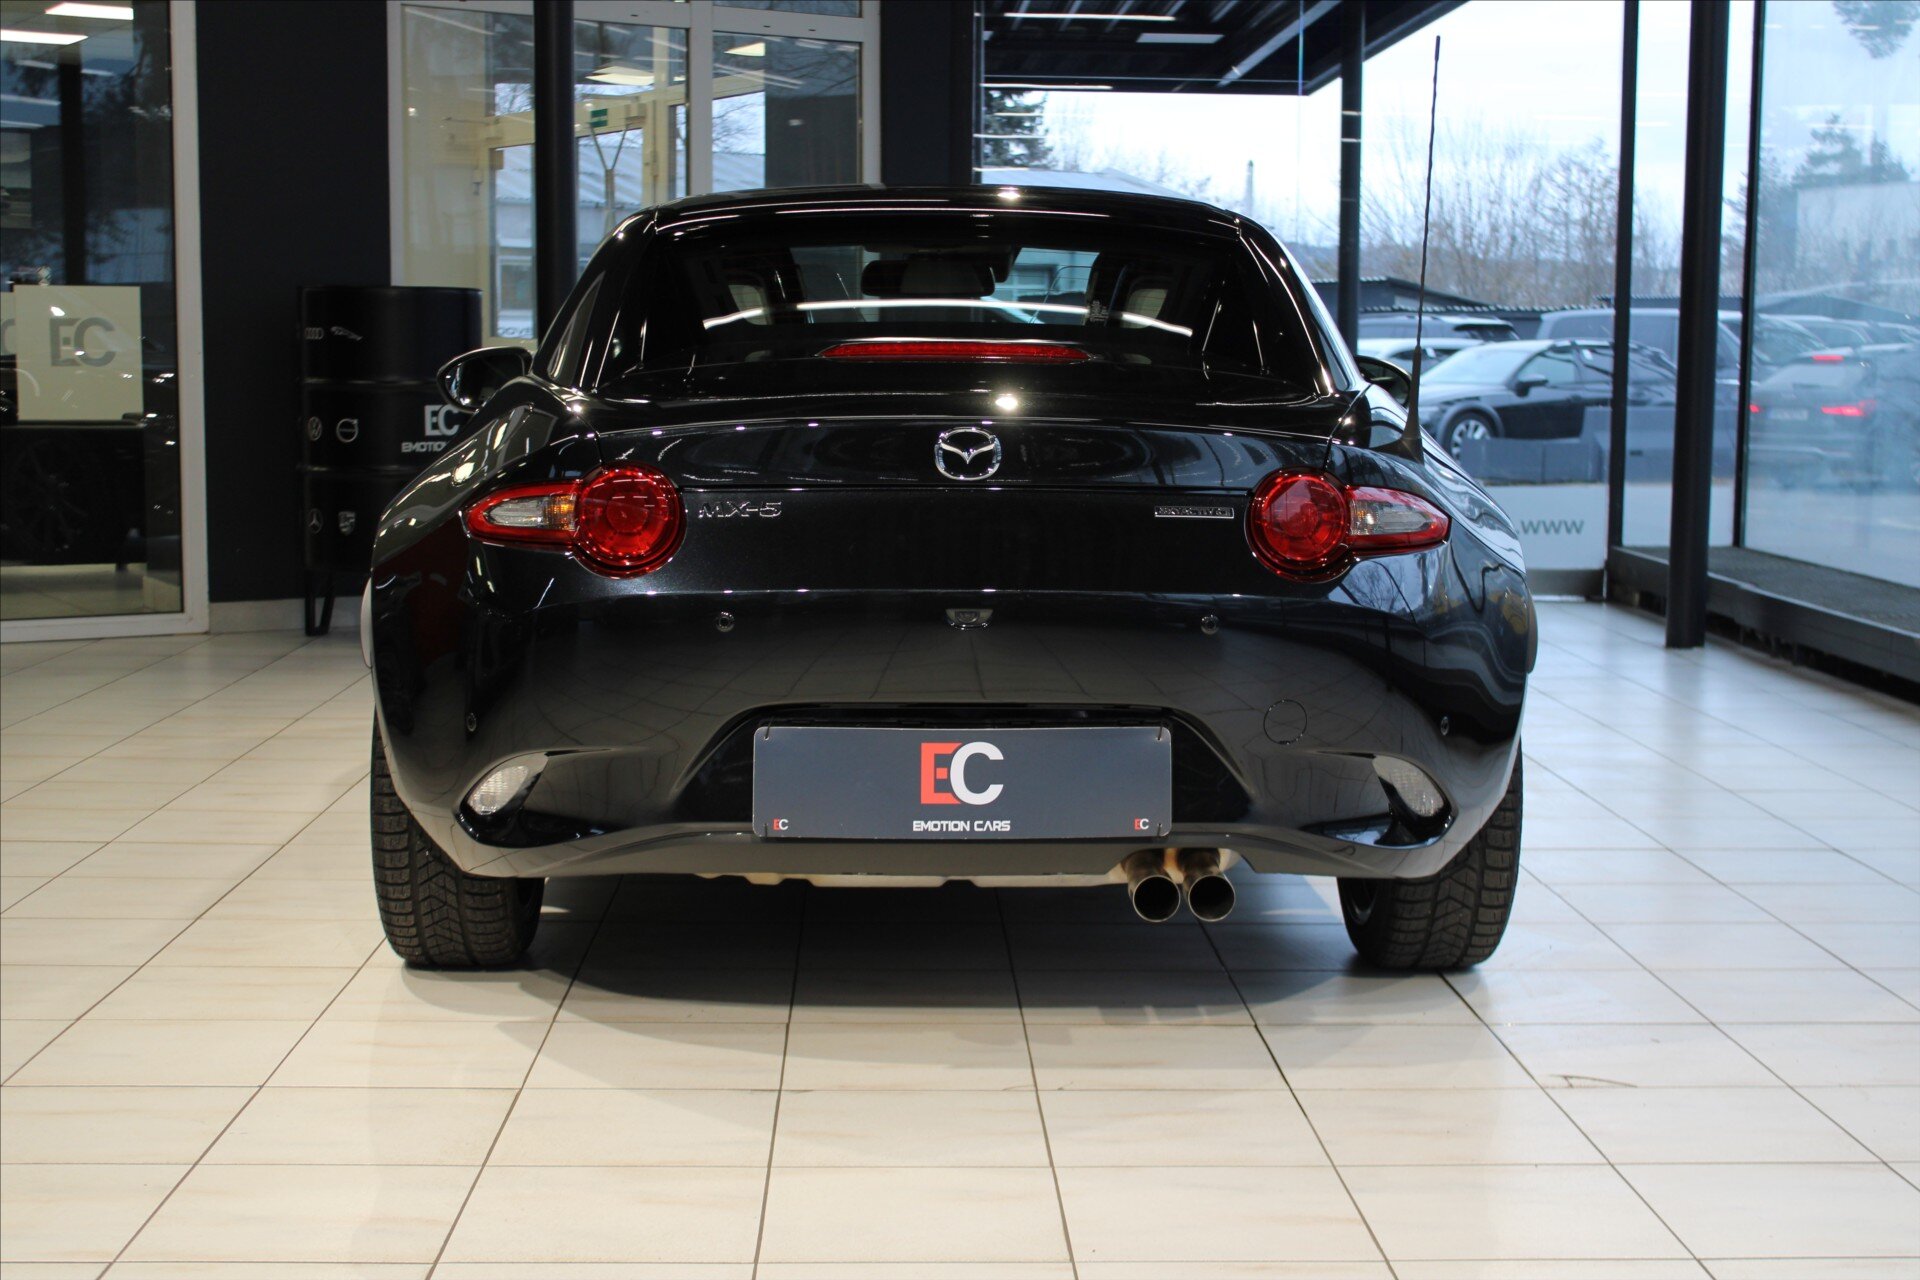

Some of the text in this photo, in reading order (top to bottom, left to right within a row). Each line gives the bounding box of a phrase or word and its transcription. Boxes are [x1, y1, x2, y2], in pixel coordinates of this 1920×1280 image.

[49, 317, 116, 367] EC
[424, 404, 460, 436] EC
[401, 441, 447, 453] EMOTIO
[698, 501, 782, 518] MX-5
[920, 741, 1004, 806] EC
[773, 818, 789, 831] EC
[912, 820, 1011, 832] EMOTION CARS
[1134, 818, 1149, 831] EC
